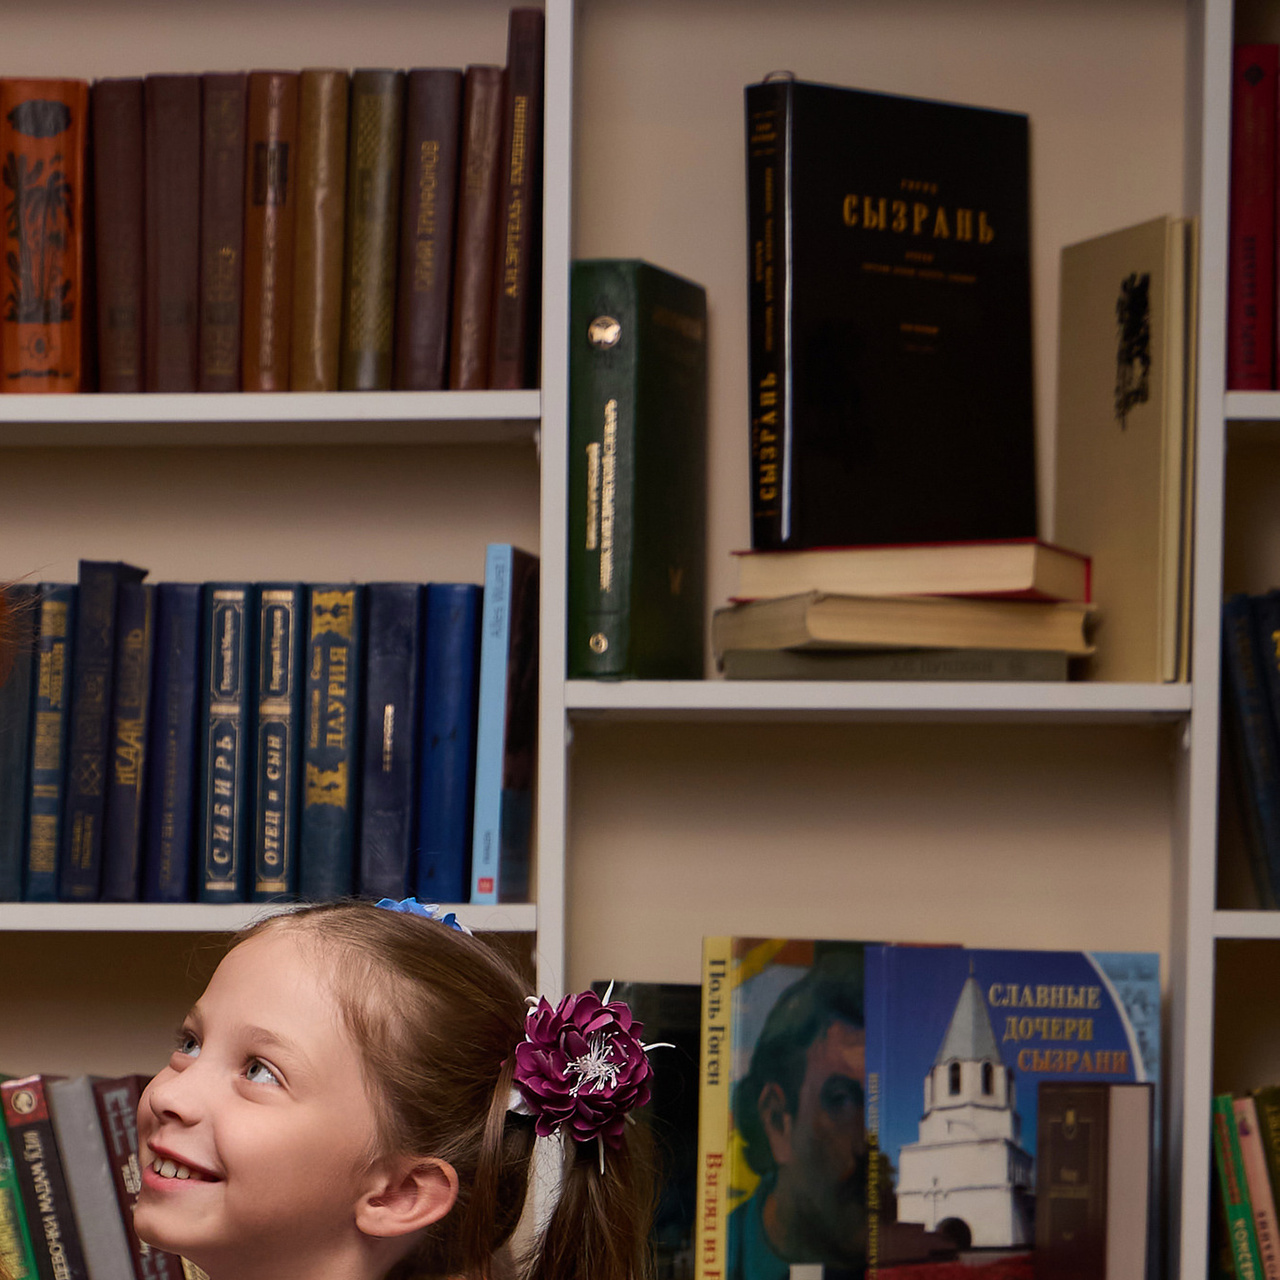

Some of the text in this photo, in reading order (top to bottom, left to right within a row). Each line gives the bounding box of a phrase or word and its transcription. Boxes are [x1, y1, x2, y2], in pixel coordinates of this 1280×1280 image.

[417, 140, 440, 235] ТРИФОНОВ
[842, 193, 996, 246] СЫЗРАНЬ
[759, 370, 778, 501] СЫЗРАНЬ
[325, 645, 348, 750] ДАУРИЯ
[115, 717, 145, 785] ИСААК
[266, 733, 283, 781] СЫН
[212, 734, 233, 865] СИБИРЬ
[264, 810, 283, 866] ОТЕЦ
[707, 958, 727, 1087] Поль Гоген
[987, 982, 1103, 1010] СЛАВНЫЕ
[1001, 1015, 1094, 1044] ДОЧЕРИ
[1015, 1048, 1130, 1076] СЫЗРАНИ
[30, 1162, 57, 1213] МАДАМ
[703, 1151, 724, 1233] Взгляд
[702, 1239, 716, 1261] из
